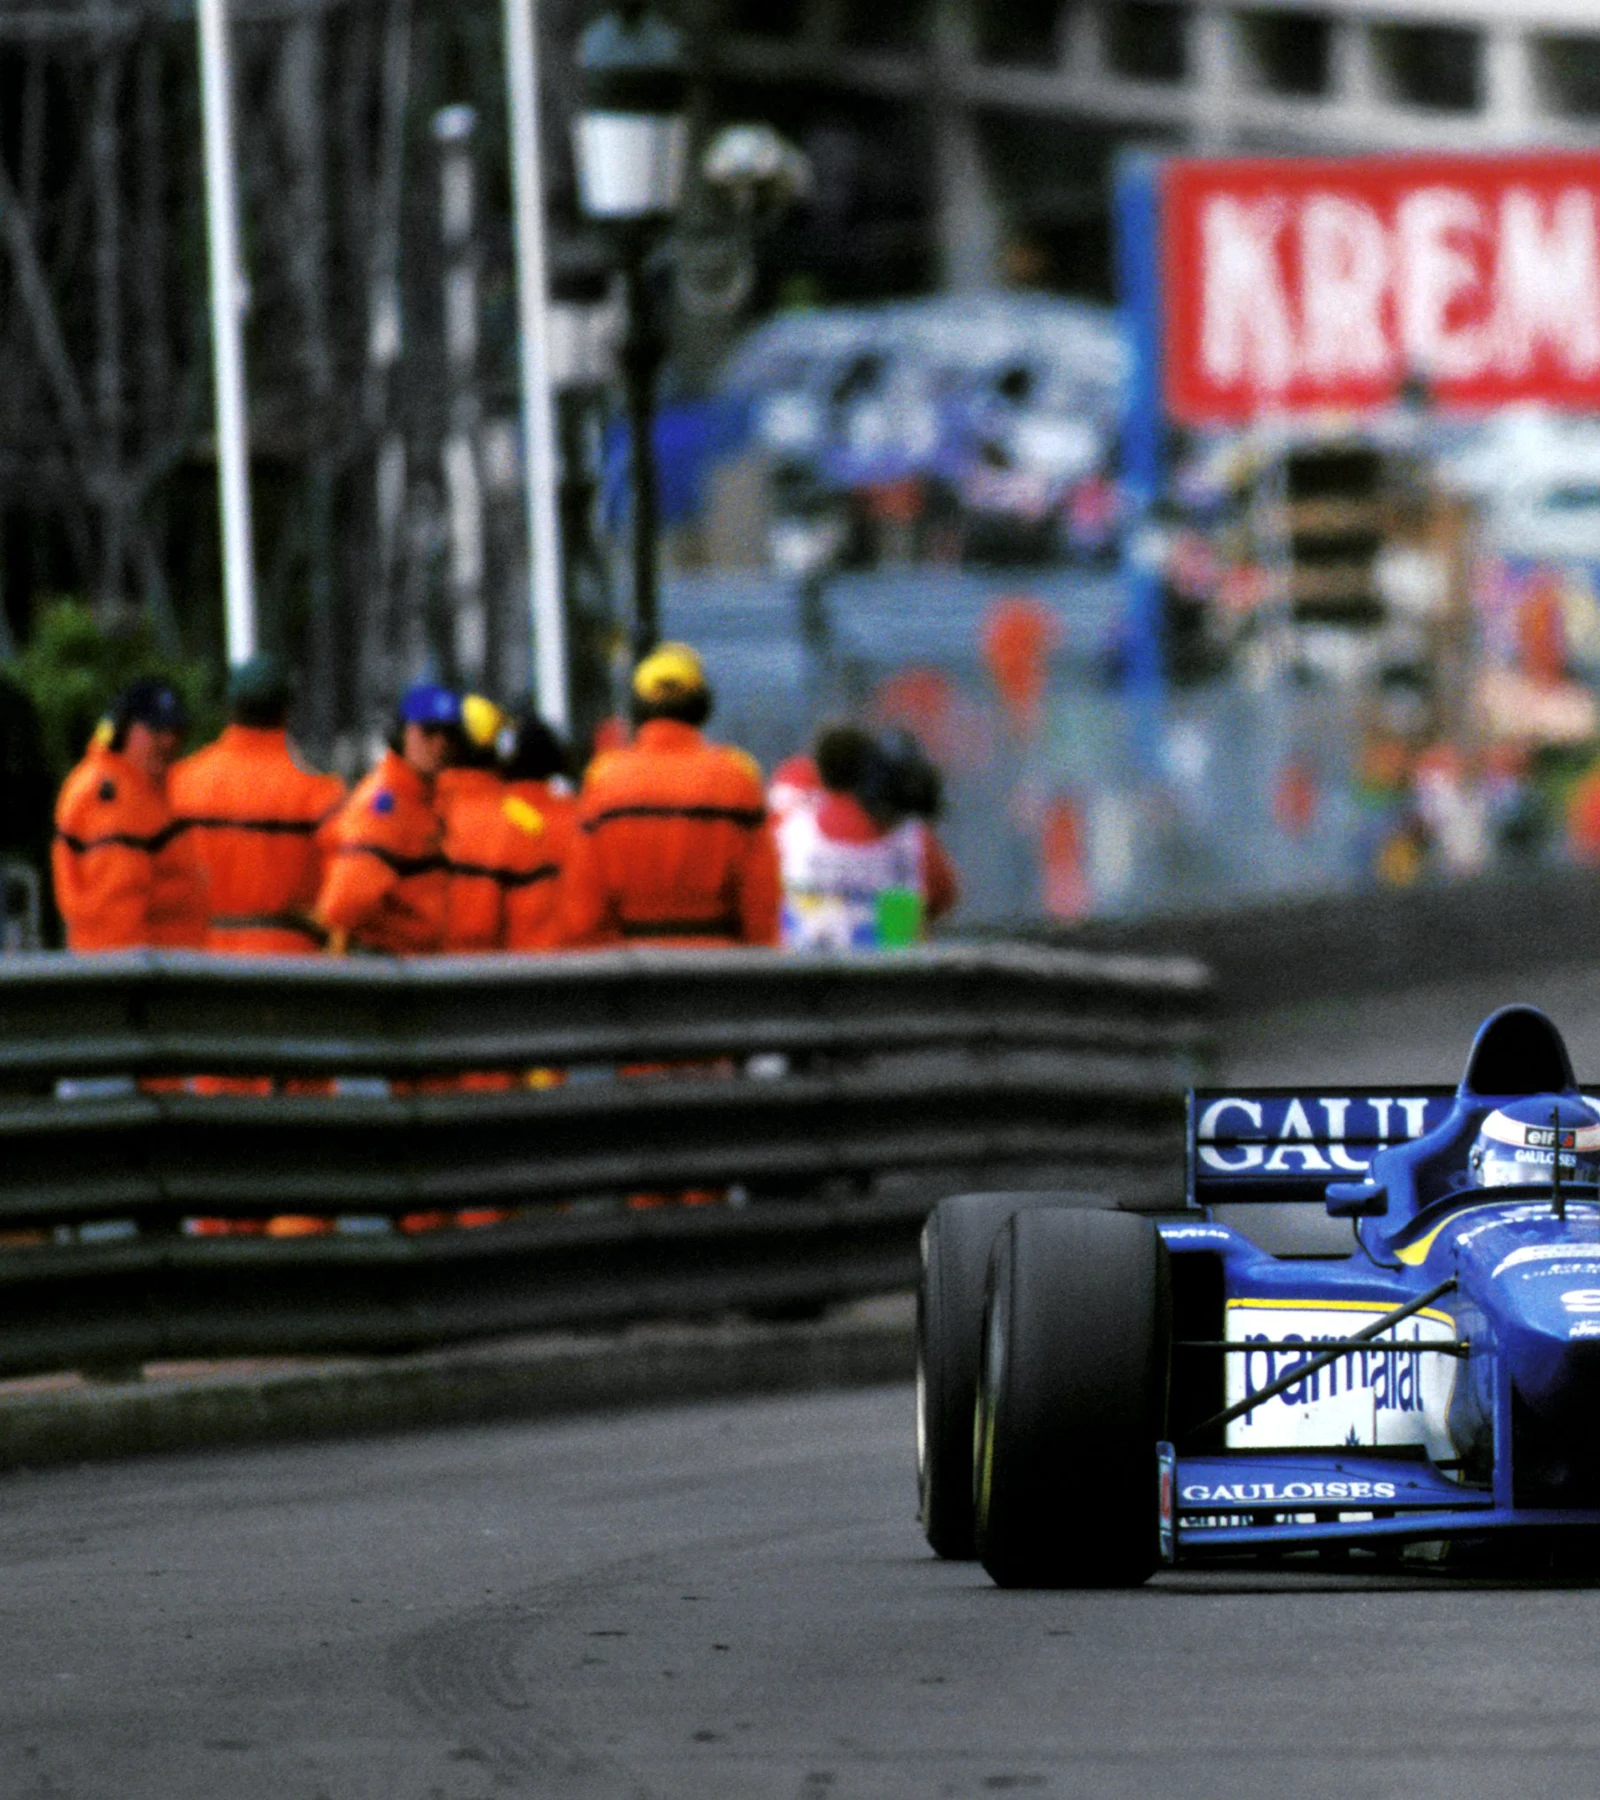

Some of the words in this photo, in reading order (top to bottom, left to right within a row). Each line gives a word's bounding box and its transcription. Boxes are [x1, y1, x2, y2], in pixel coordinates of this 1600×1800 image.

[1527, 1130, 1555, 1145] elf
[1515, 1148, 1578, 1167] GAULOSES
[1243, 1323, 1425, 1427] parmalat
[1182, 1482, 1396, 1502] GAULOISES
